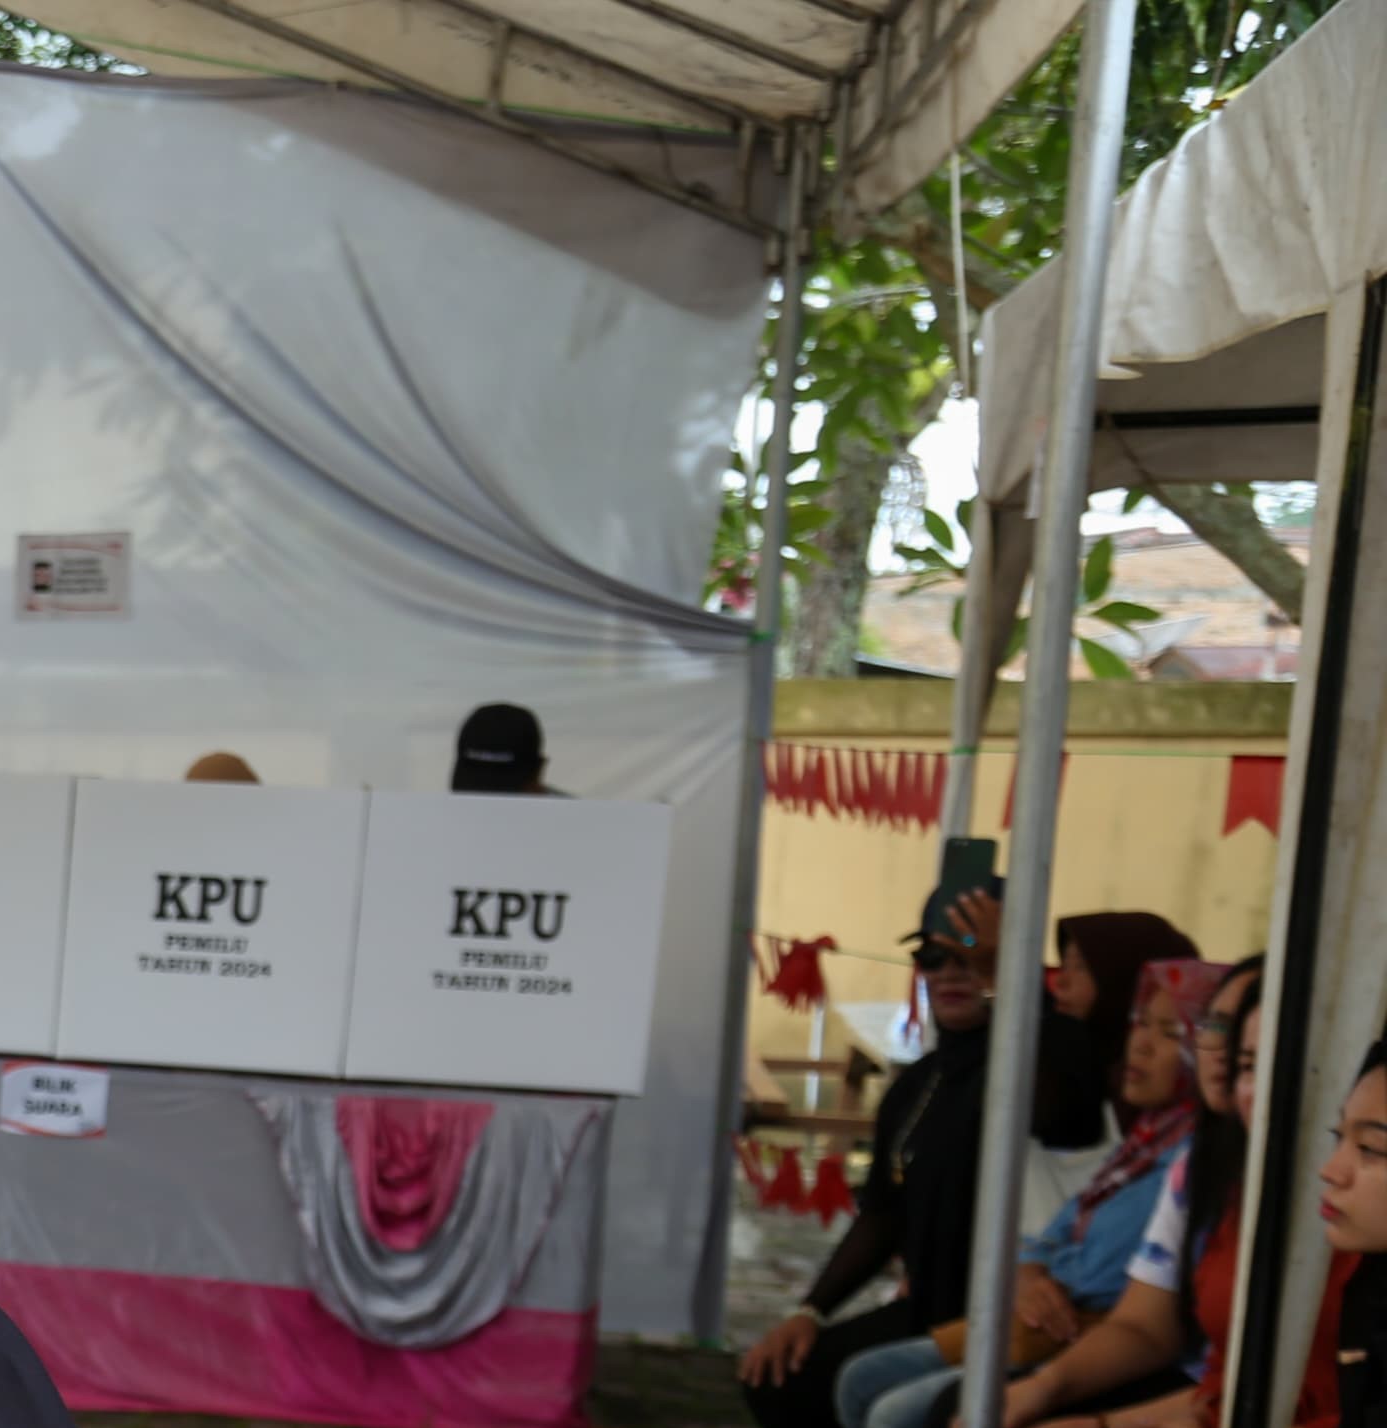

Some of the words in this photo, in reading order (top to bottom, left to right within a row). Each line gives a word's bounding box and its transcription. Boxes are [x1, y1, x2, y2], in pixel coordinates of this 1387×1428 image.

[153, 874, 268, 926] KPU
[449, 889, 570, 942] KPU
[164, 933, 249, 954] PEMILU
[138, 955, 211, 974] TAHUN
[219, 961, 273, 979] 2024
[460, 949, 549, 971] PEMILU
[432, 972, 510, 991] TAHUN
[517, 977, 573, 996] 2024
[31, 1076, 77, 1093] BILIK
[24, 1098, 84, 1116] SUARA
